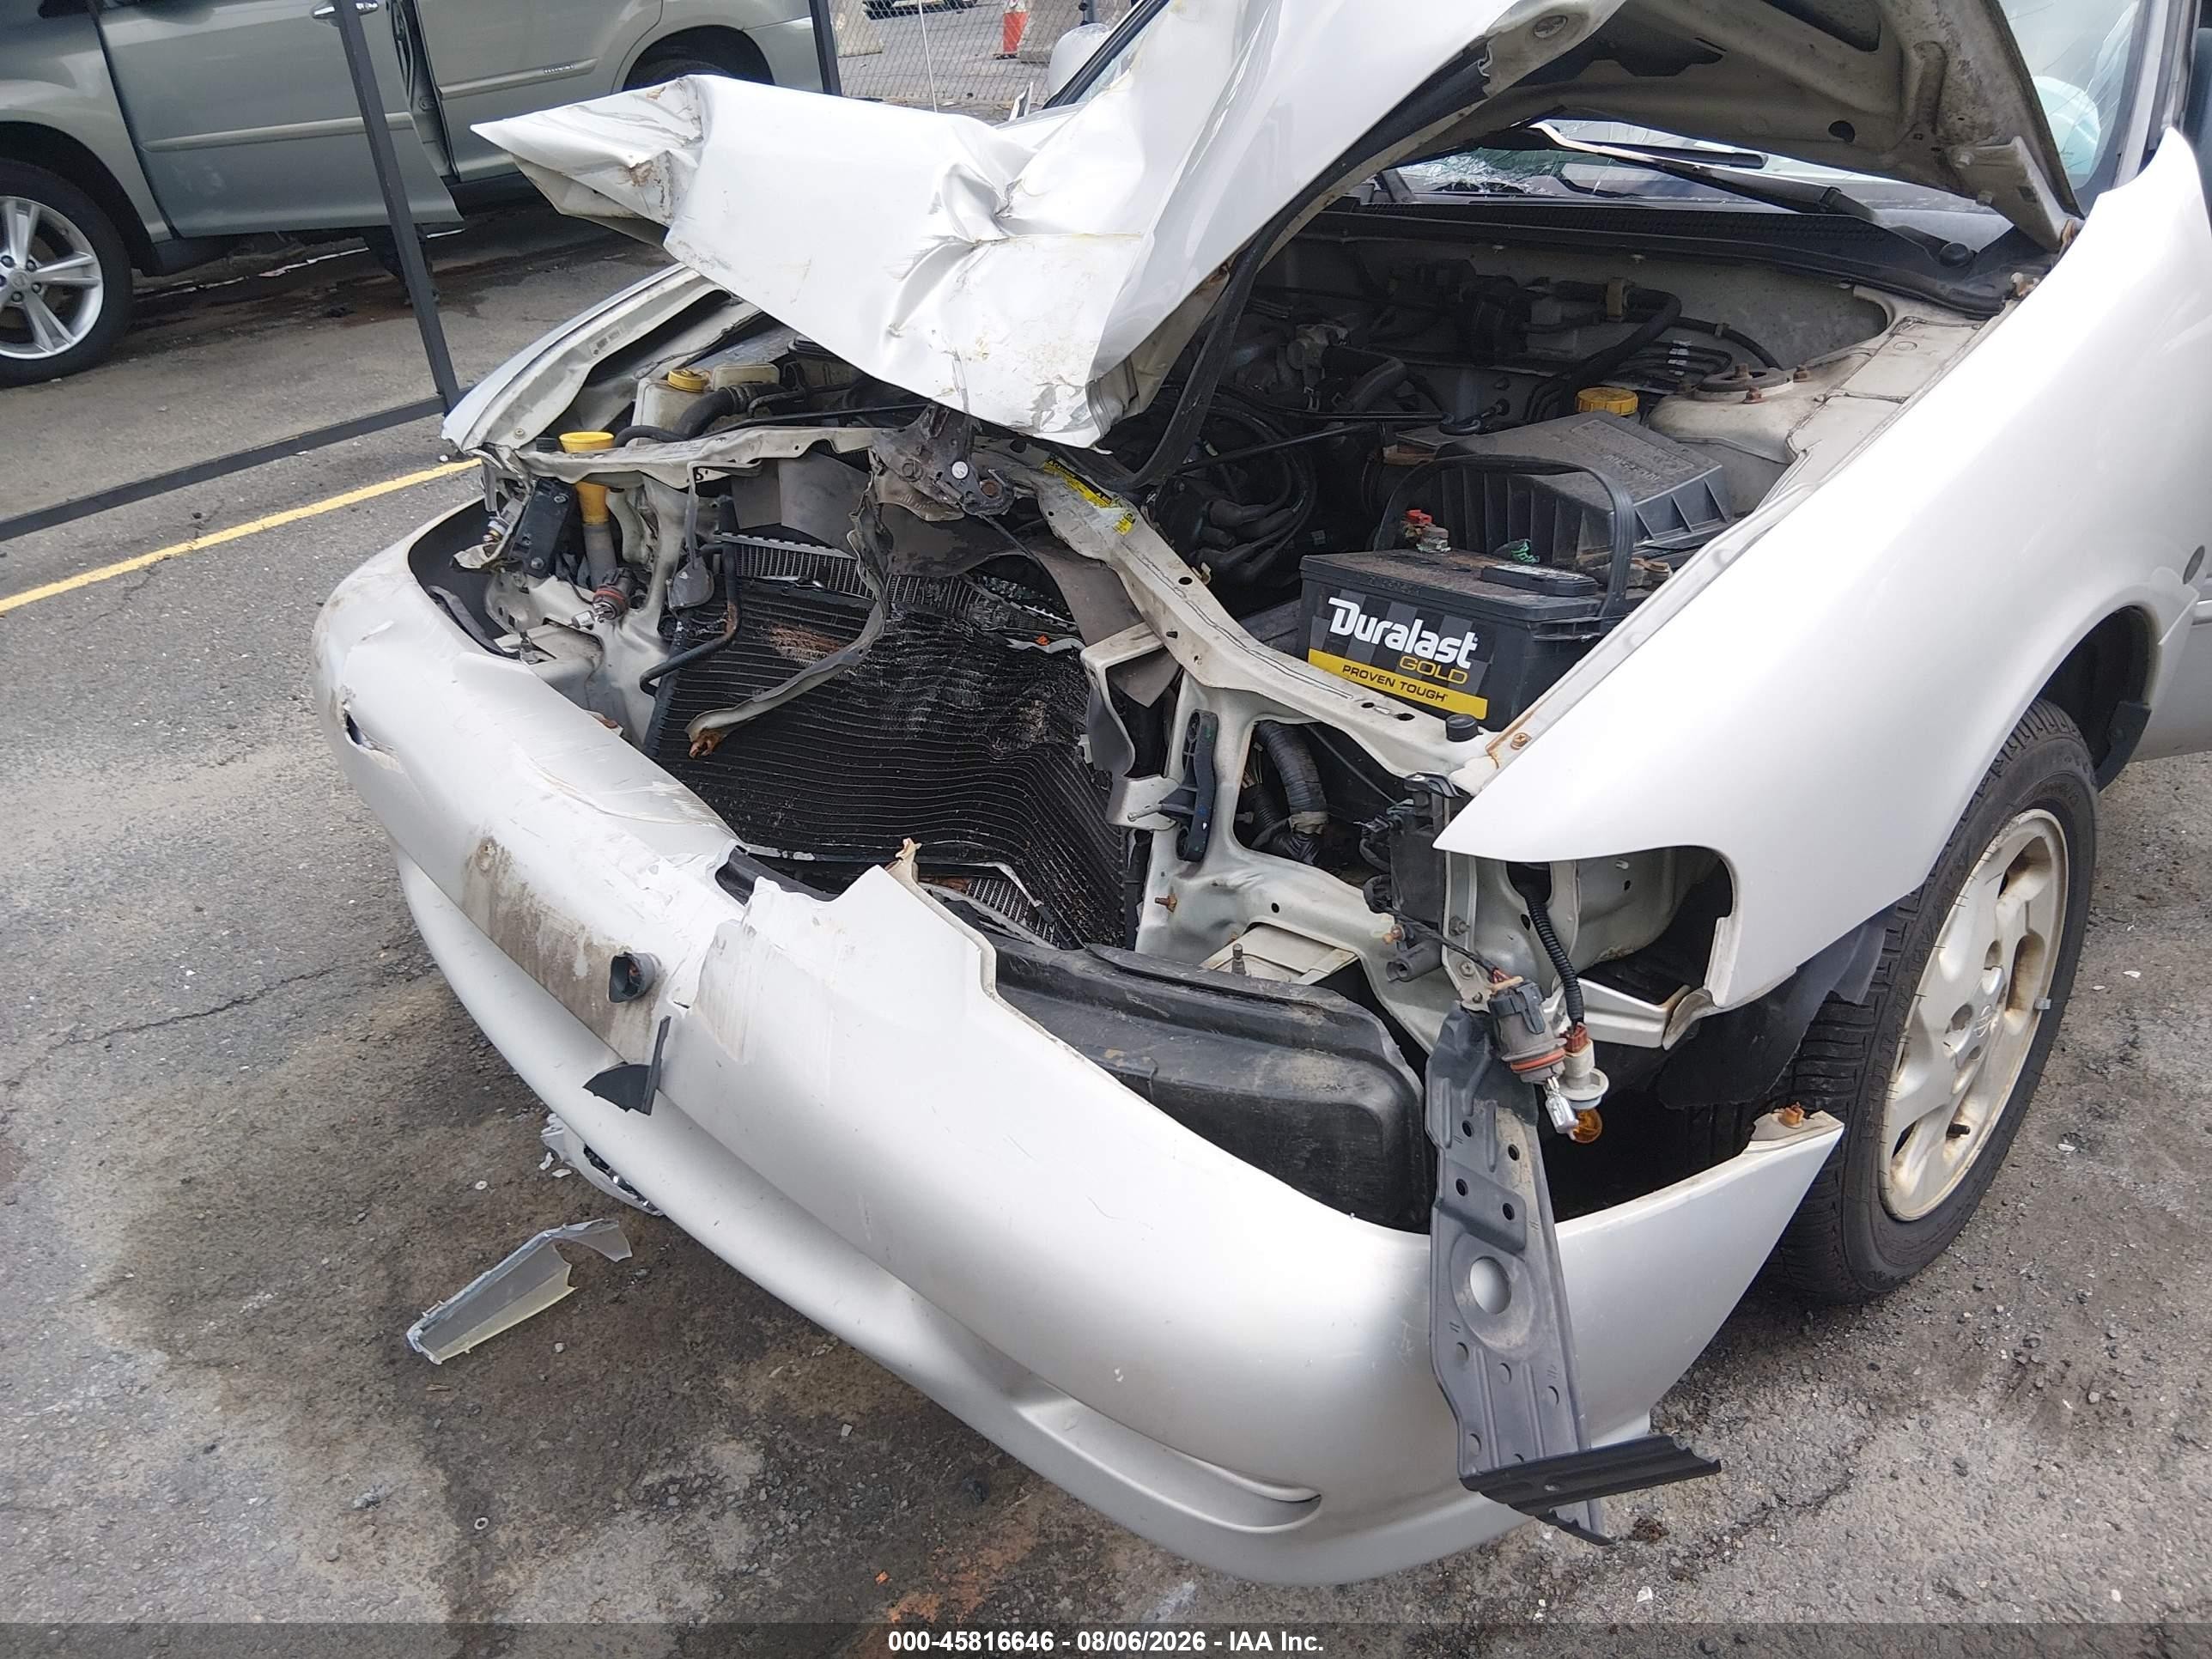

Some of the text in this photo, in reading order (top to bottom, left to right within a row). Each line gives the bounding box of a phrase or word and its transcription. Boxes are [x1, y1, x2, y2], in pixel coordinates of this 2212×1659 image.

[1328, 597, 1478, 670] Duralast
[1342, 665, 1447, 702] PROVEN TOUGH
[1399, 655, 1468, 684] GOLD
